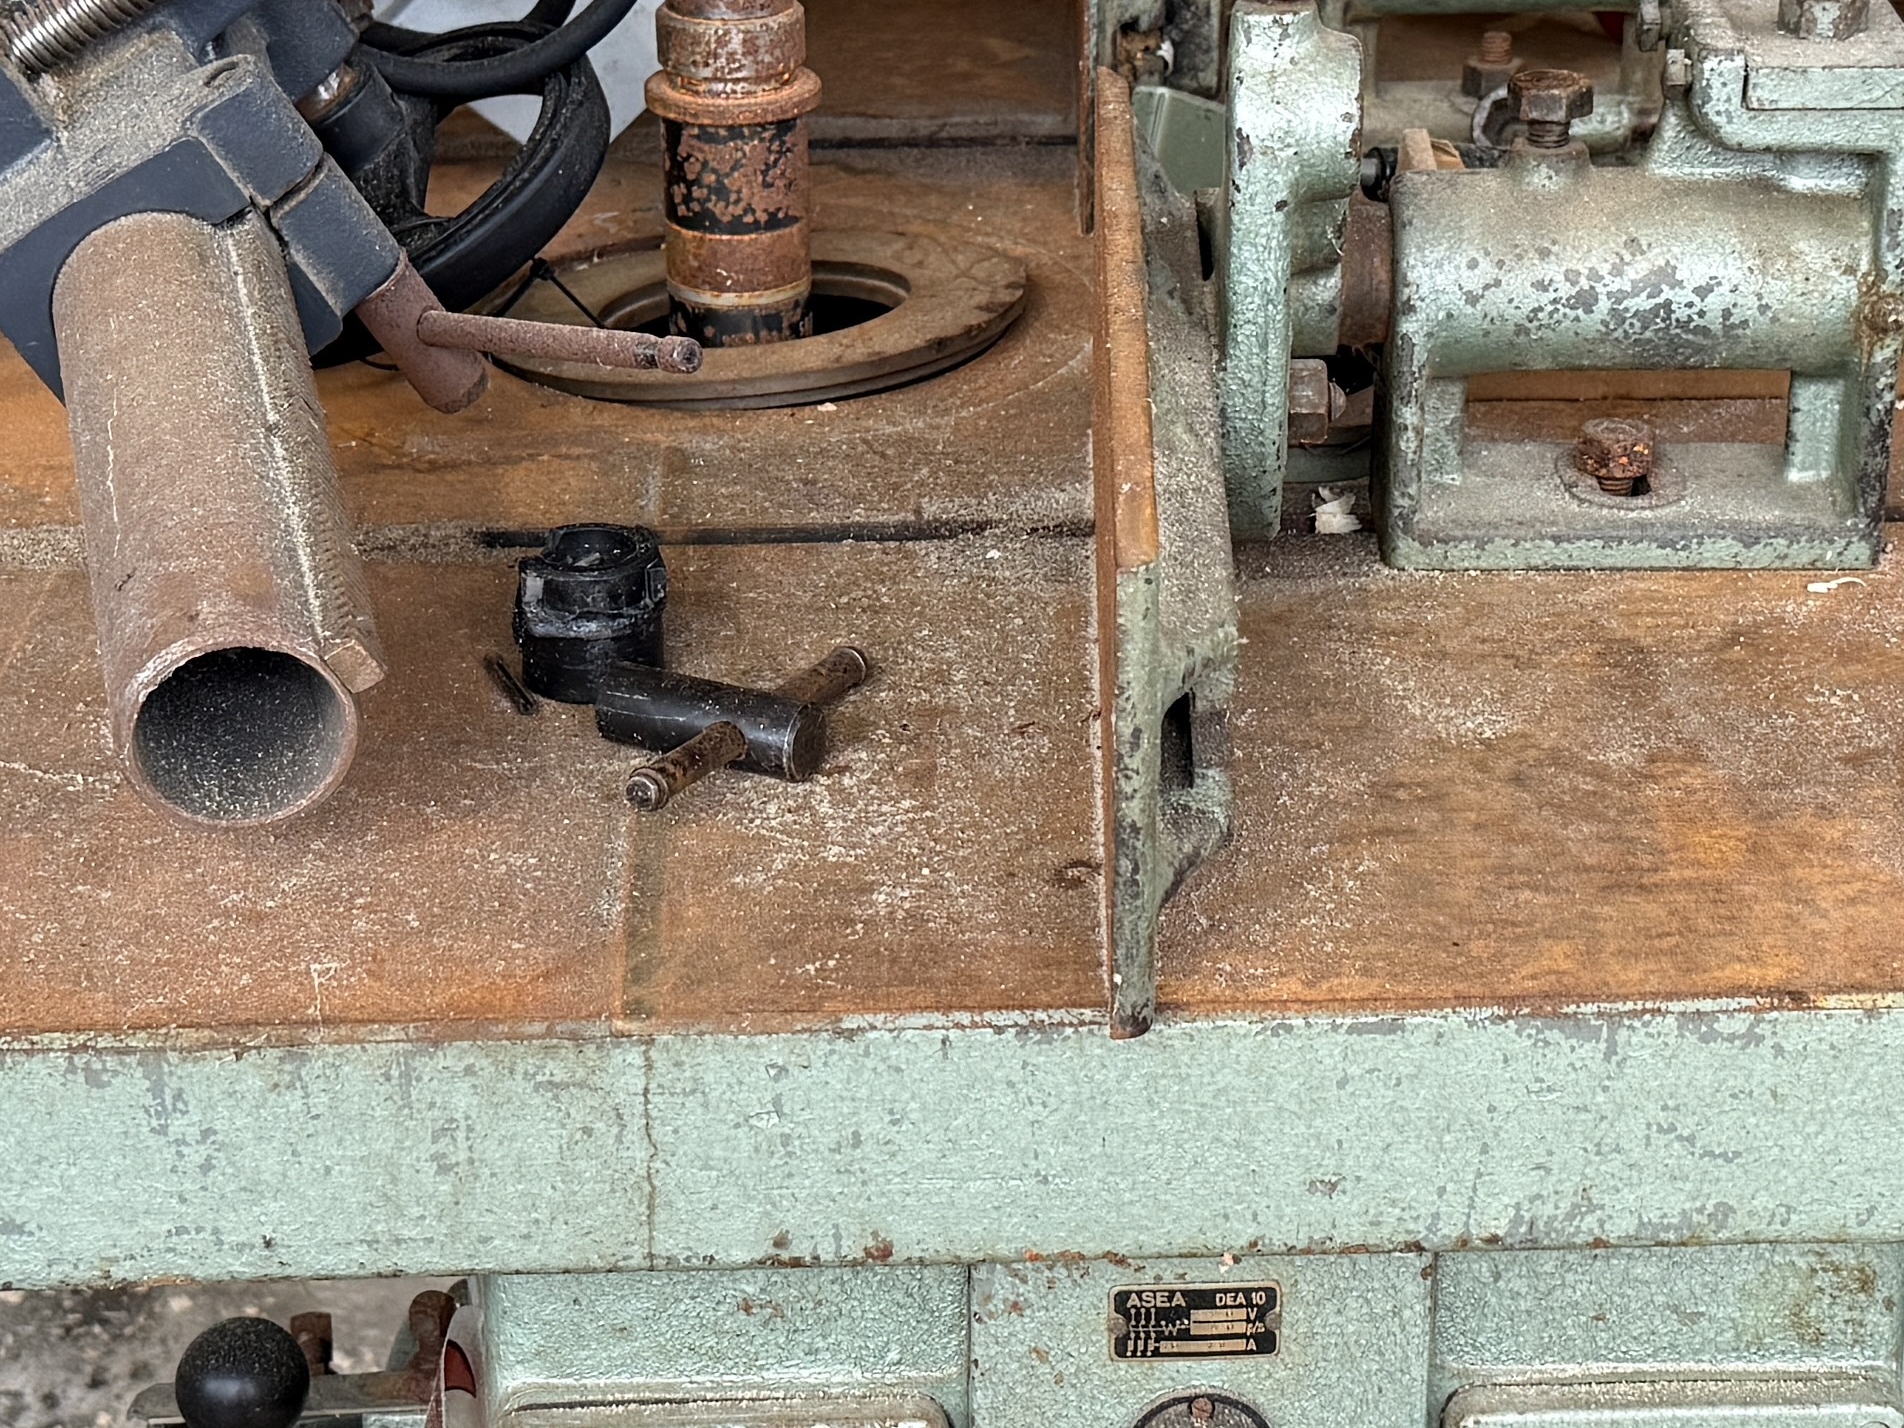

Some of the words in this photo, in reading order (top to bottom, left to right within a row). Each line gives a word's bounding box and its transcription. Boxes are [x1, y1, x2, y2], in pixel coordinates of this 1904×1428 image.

[1126, 1291, 1187, 1308] ASEA
[1215, 1292, 1246, 1307] DEA
[1250, 1291, 1266, 1306] 10
[1247, 1307, 1257, 1320] V
[1246, 1338, 1257, 1351] A
